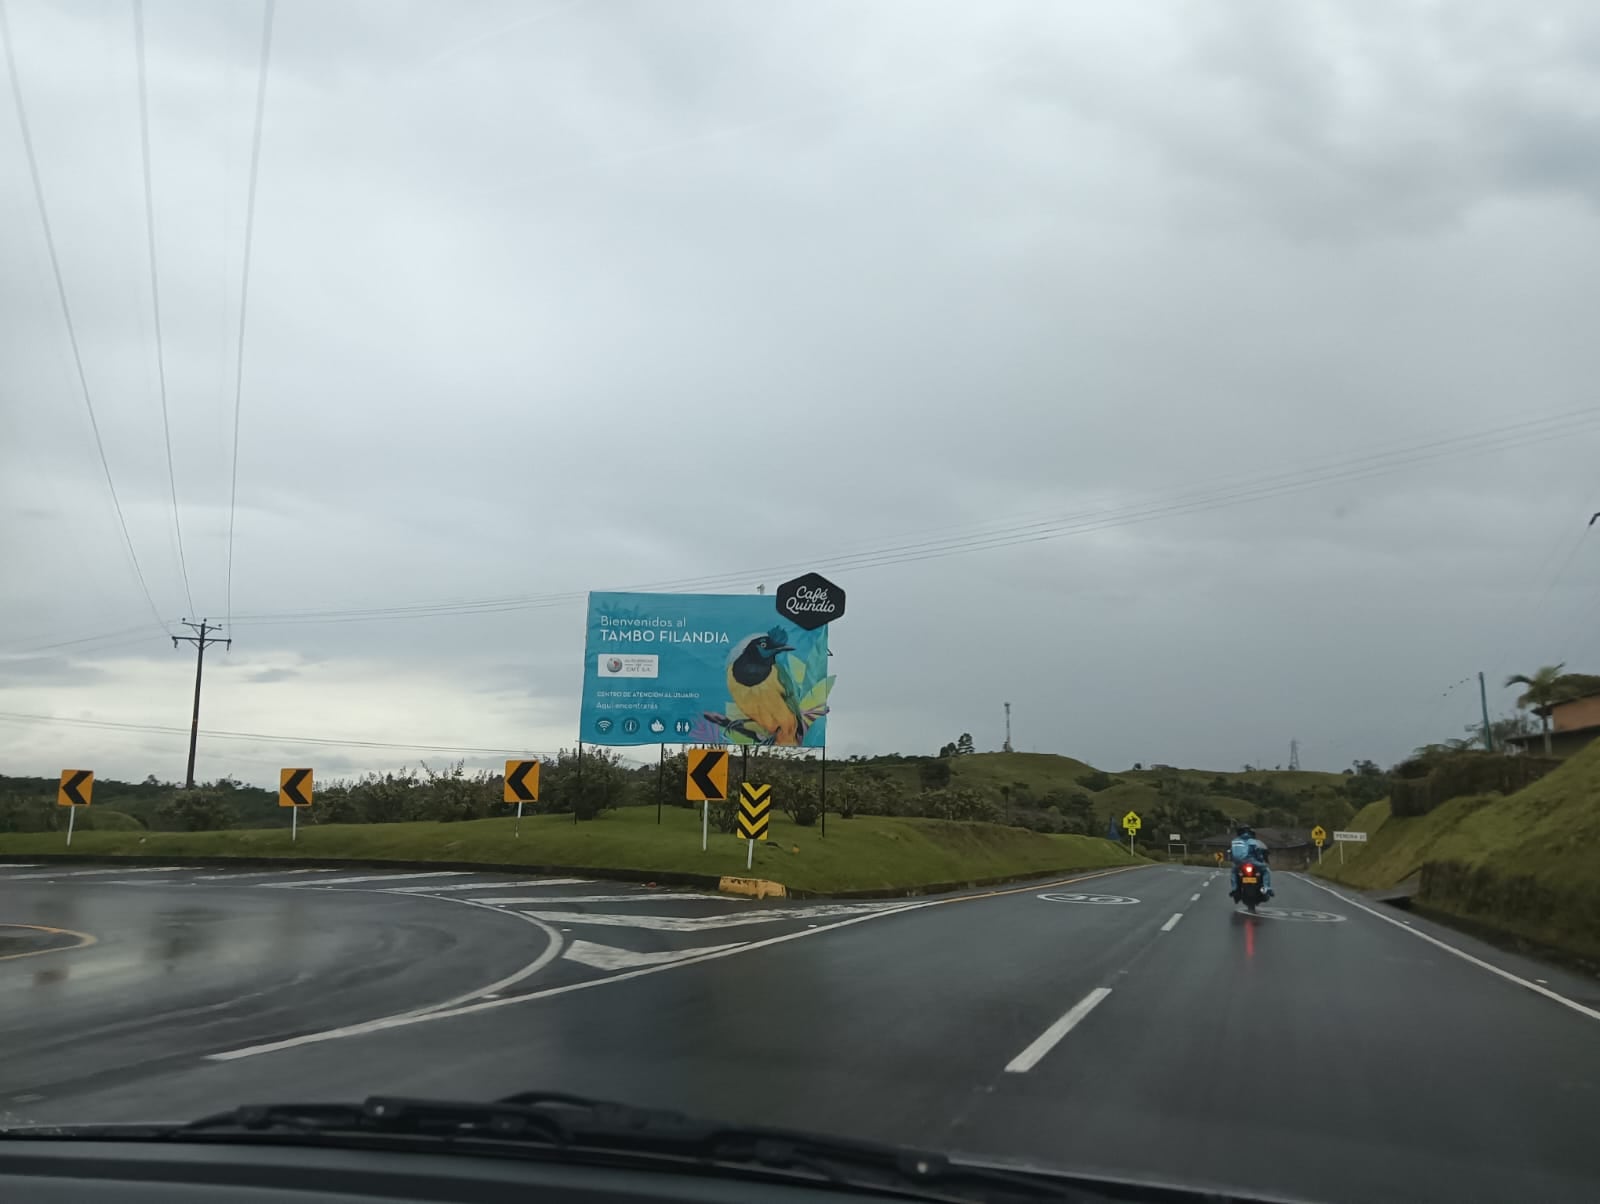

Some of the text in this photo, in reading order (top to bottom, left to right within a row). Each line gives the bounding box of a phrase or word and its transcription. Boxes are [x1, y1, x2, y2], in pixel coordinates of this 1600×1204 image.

[796, 585, 828, 603] Café
[785, 596, 836, 614] Quindío
[600, 615, 687, 628] Bienvenidos al
[600, 629, 730, 644] TAMBO FILANDIA
